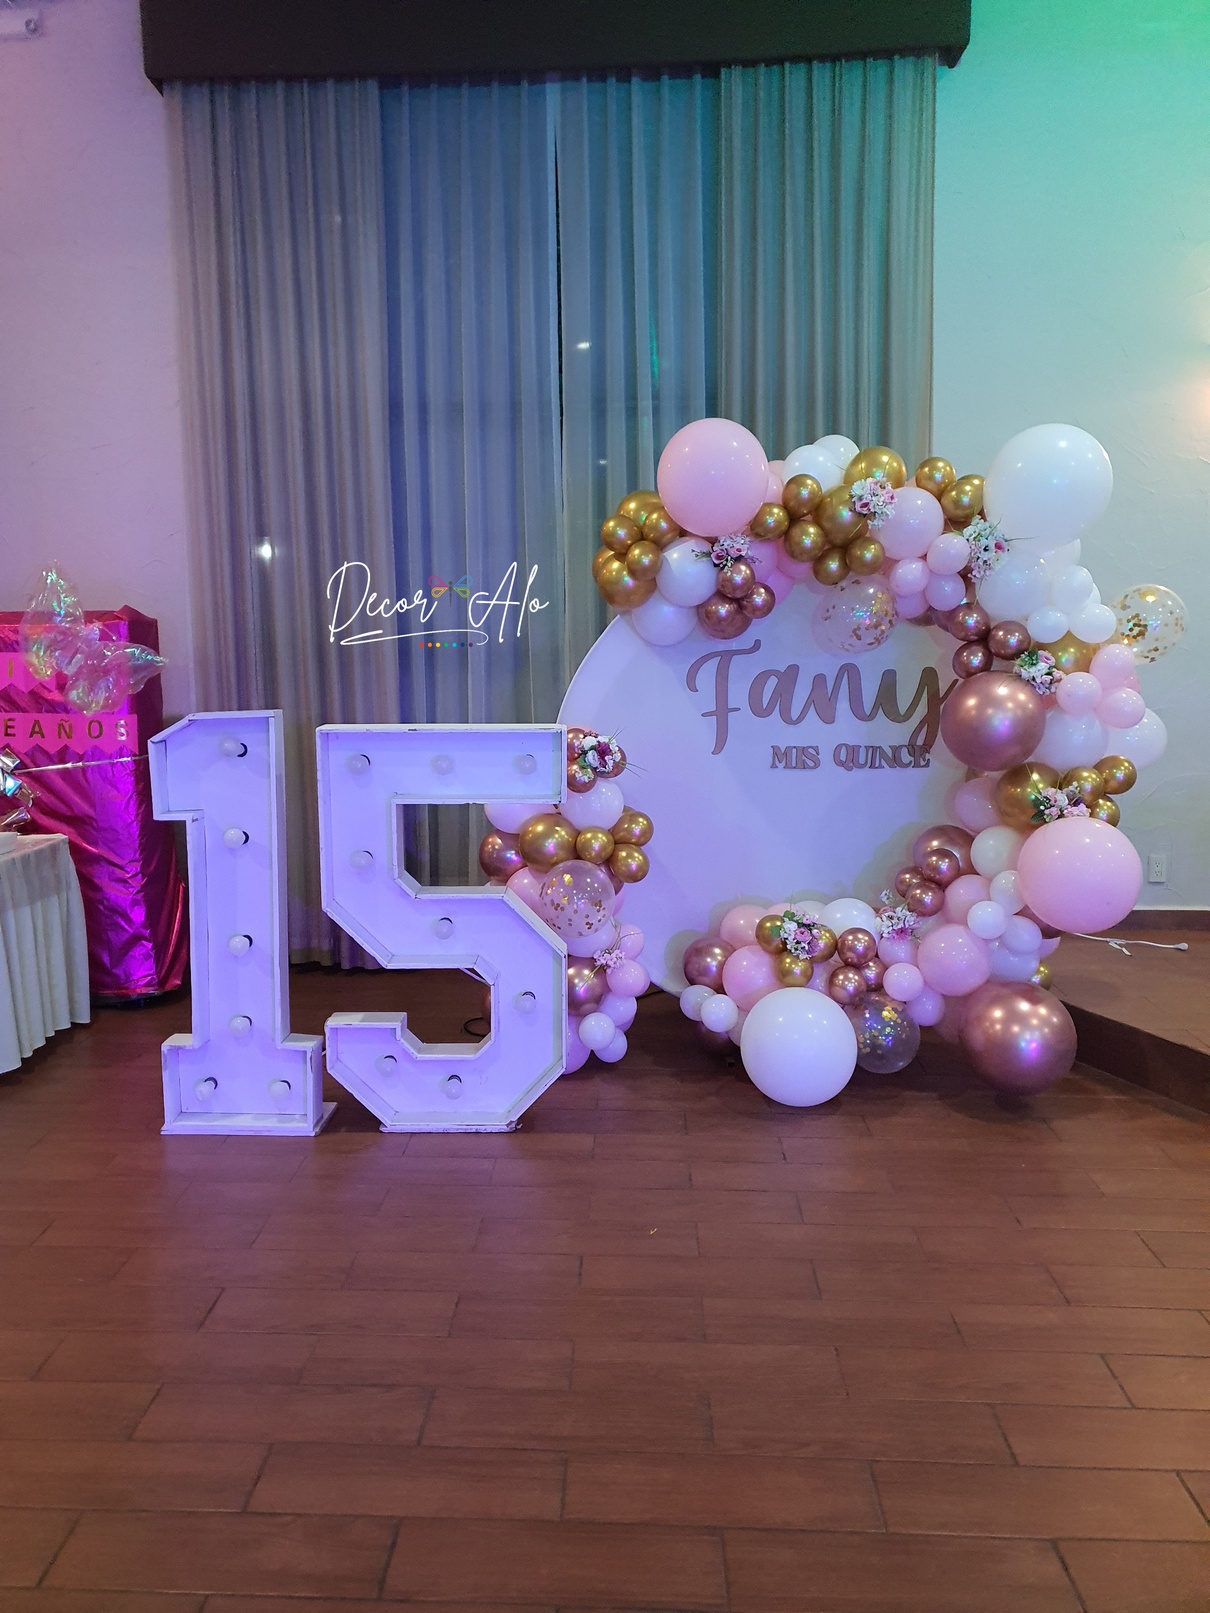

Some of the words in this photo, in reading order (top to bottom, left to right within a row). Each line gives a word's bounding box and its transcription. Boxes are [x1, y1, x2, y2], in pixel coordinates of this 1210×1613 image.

[686, 638, 959, 756] Fany
[770, 744, 821, 770] MIS
[833, 743, 931, 772] QUINCE
[149, 709, 568, 1137] 15
